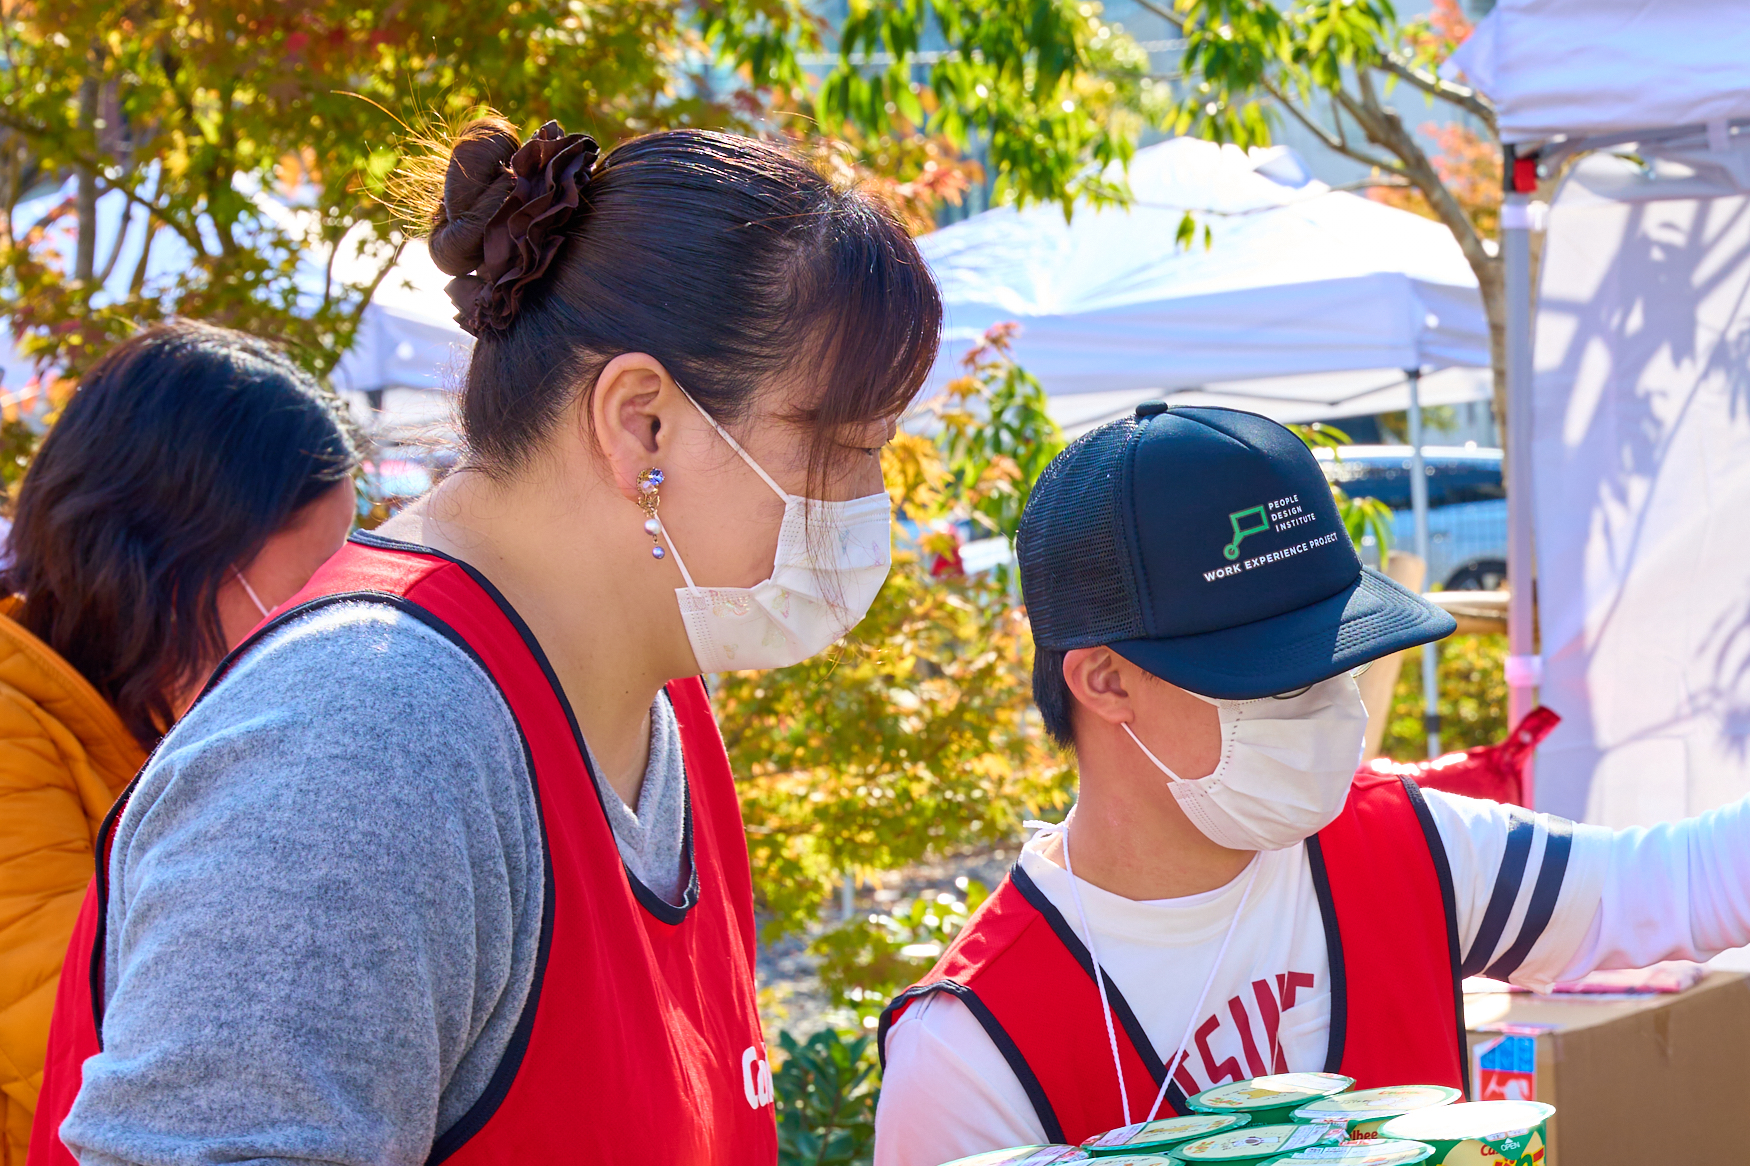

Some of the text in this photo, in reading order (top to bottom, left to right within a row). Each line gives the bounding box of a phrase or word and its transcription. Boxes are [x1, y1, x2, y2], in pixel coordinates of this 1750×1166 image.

[1268, 494, 1299, 511] PEOPLE
[1271, 505, 1303, 522] DESIGN
[1275, 512, 1316, 533] INSTITUTE
[1203, 532, 1339, 582] WORK EXPERIENCE PROJECT
